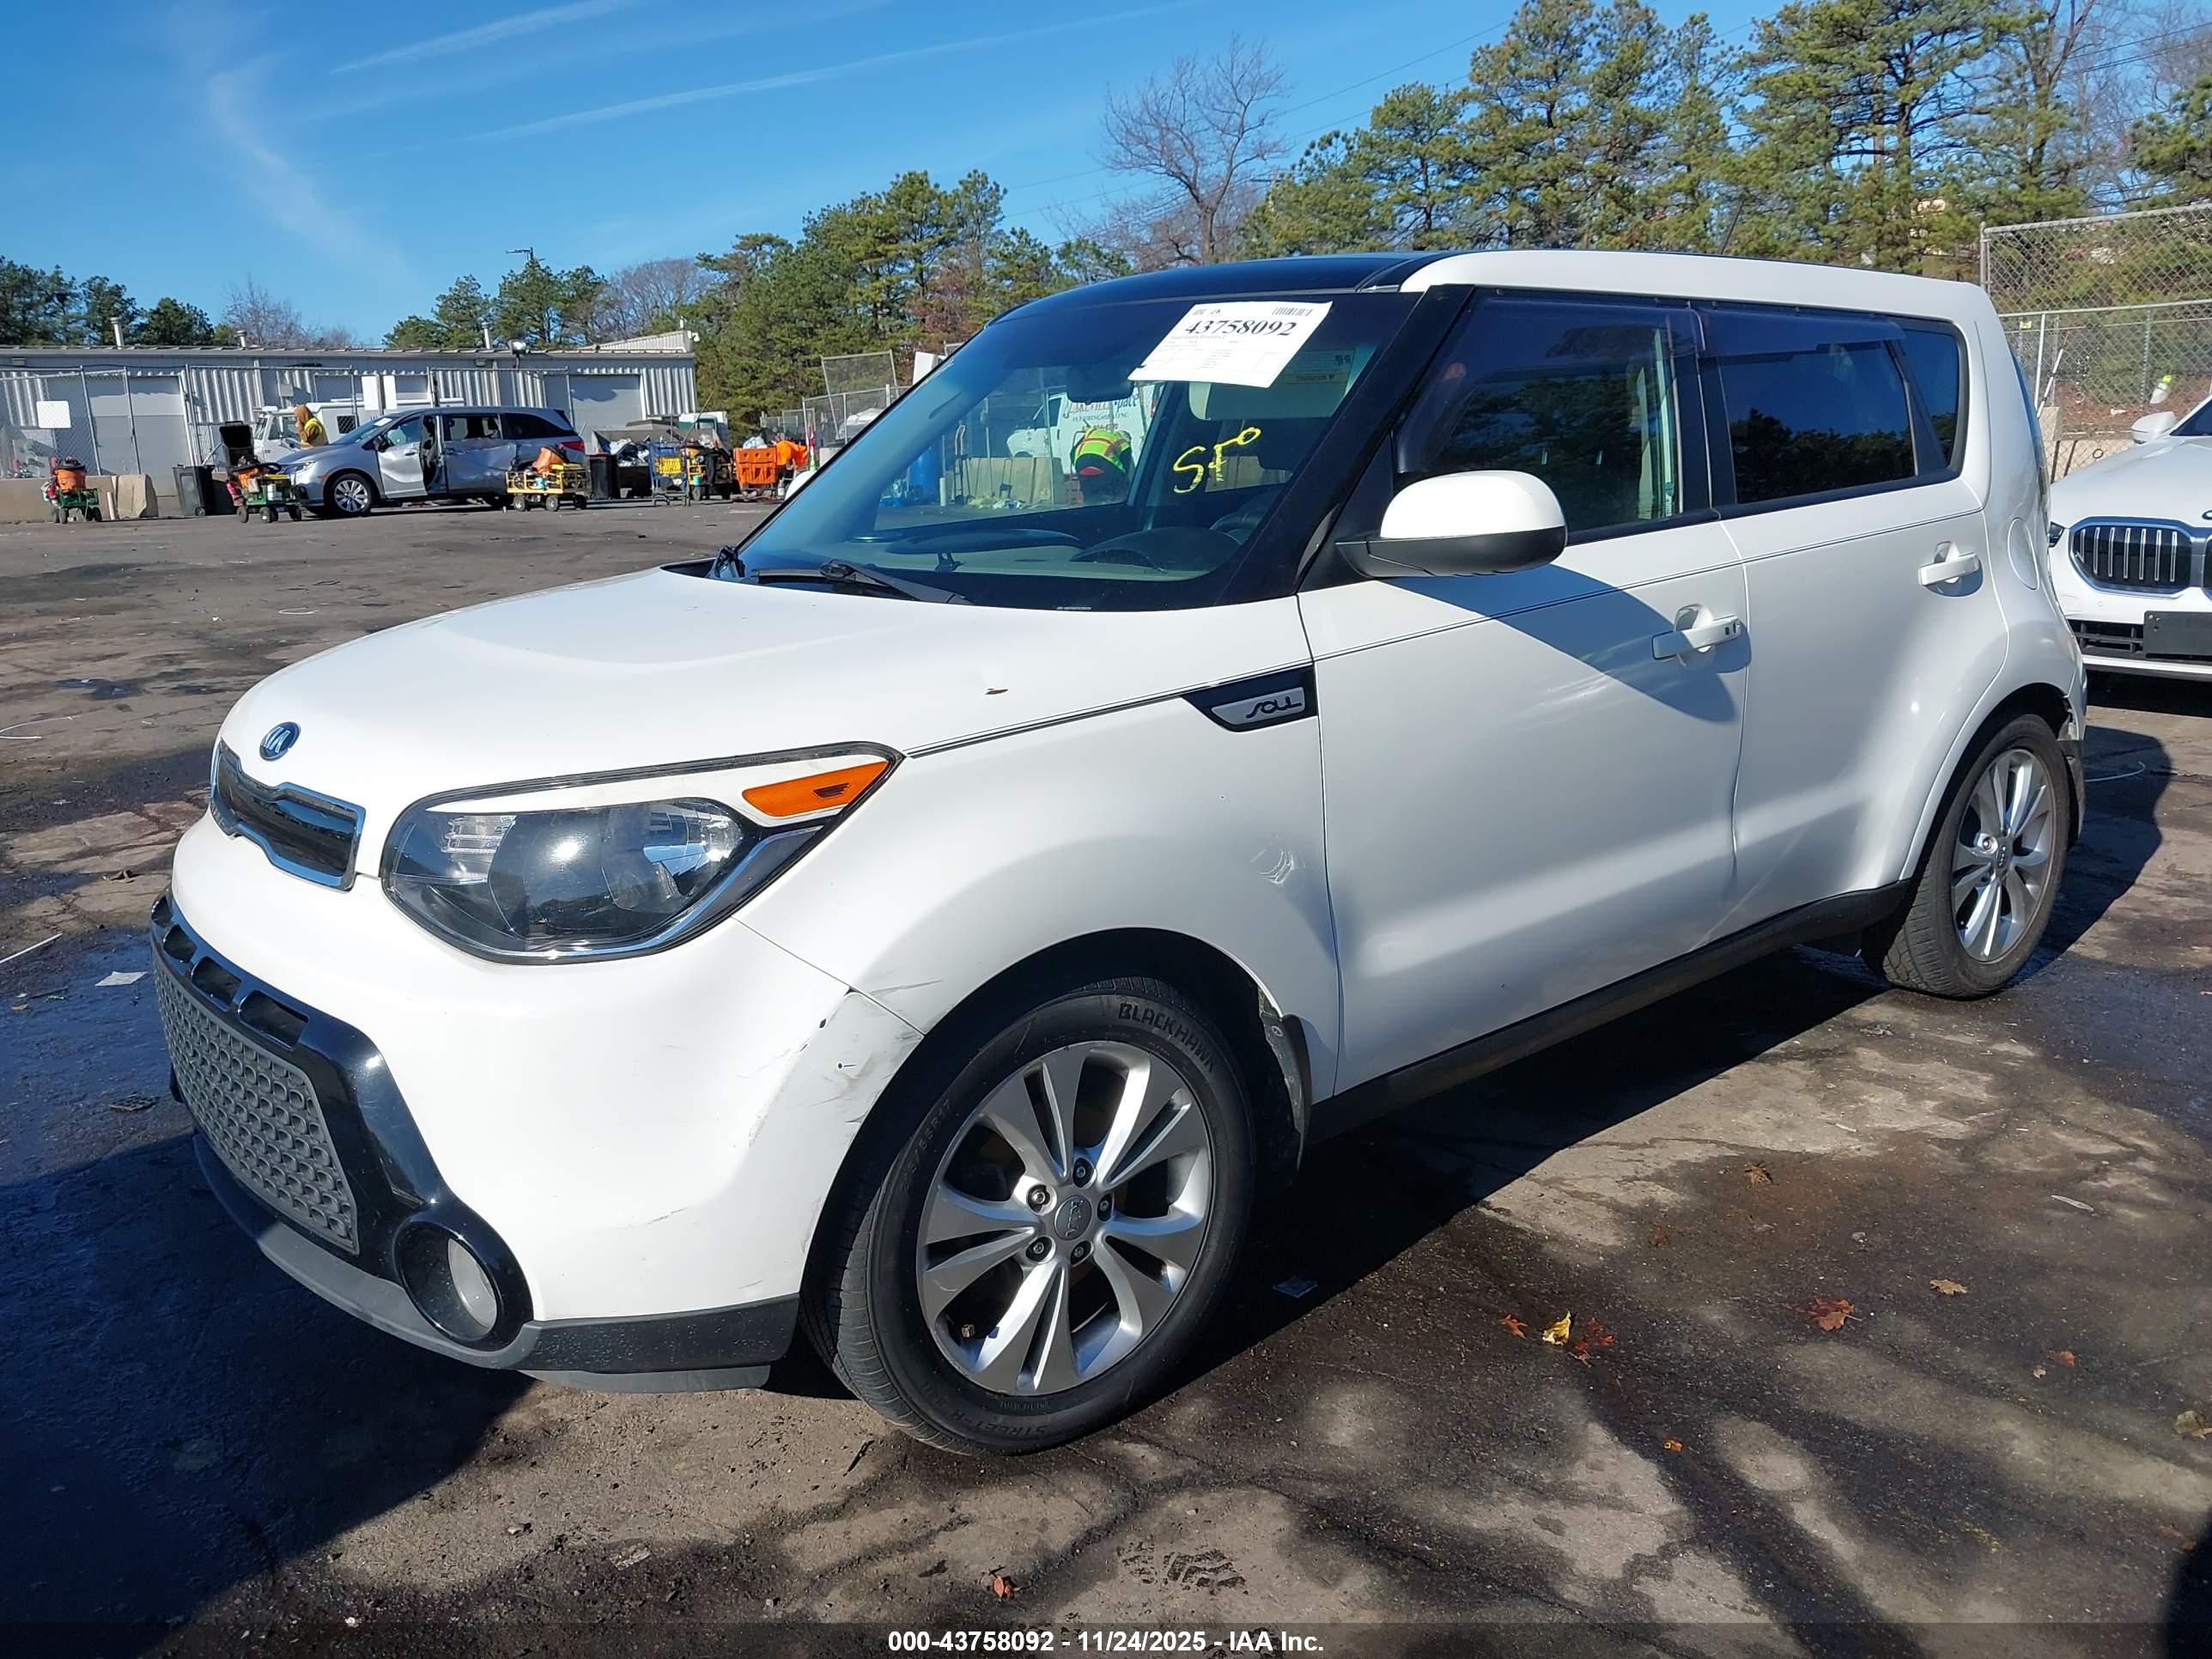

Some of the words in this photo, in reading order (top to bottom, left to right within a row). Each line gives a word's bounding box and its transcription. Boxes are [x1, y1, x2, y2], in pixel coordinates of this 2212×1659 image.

[1184, 319, 1297, 336] 43758092
[1246, 696, 1302, 719] SOUL
[1118, 1002, 1213, 1073] BLACKHAWK
